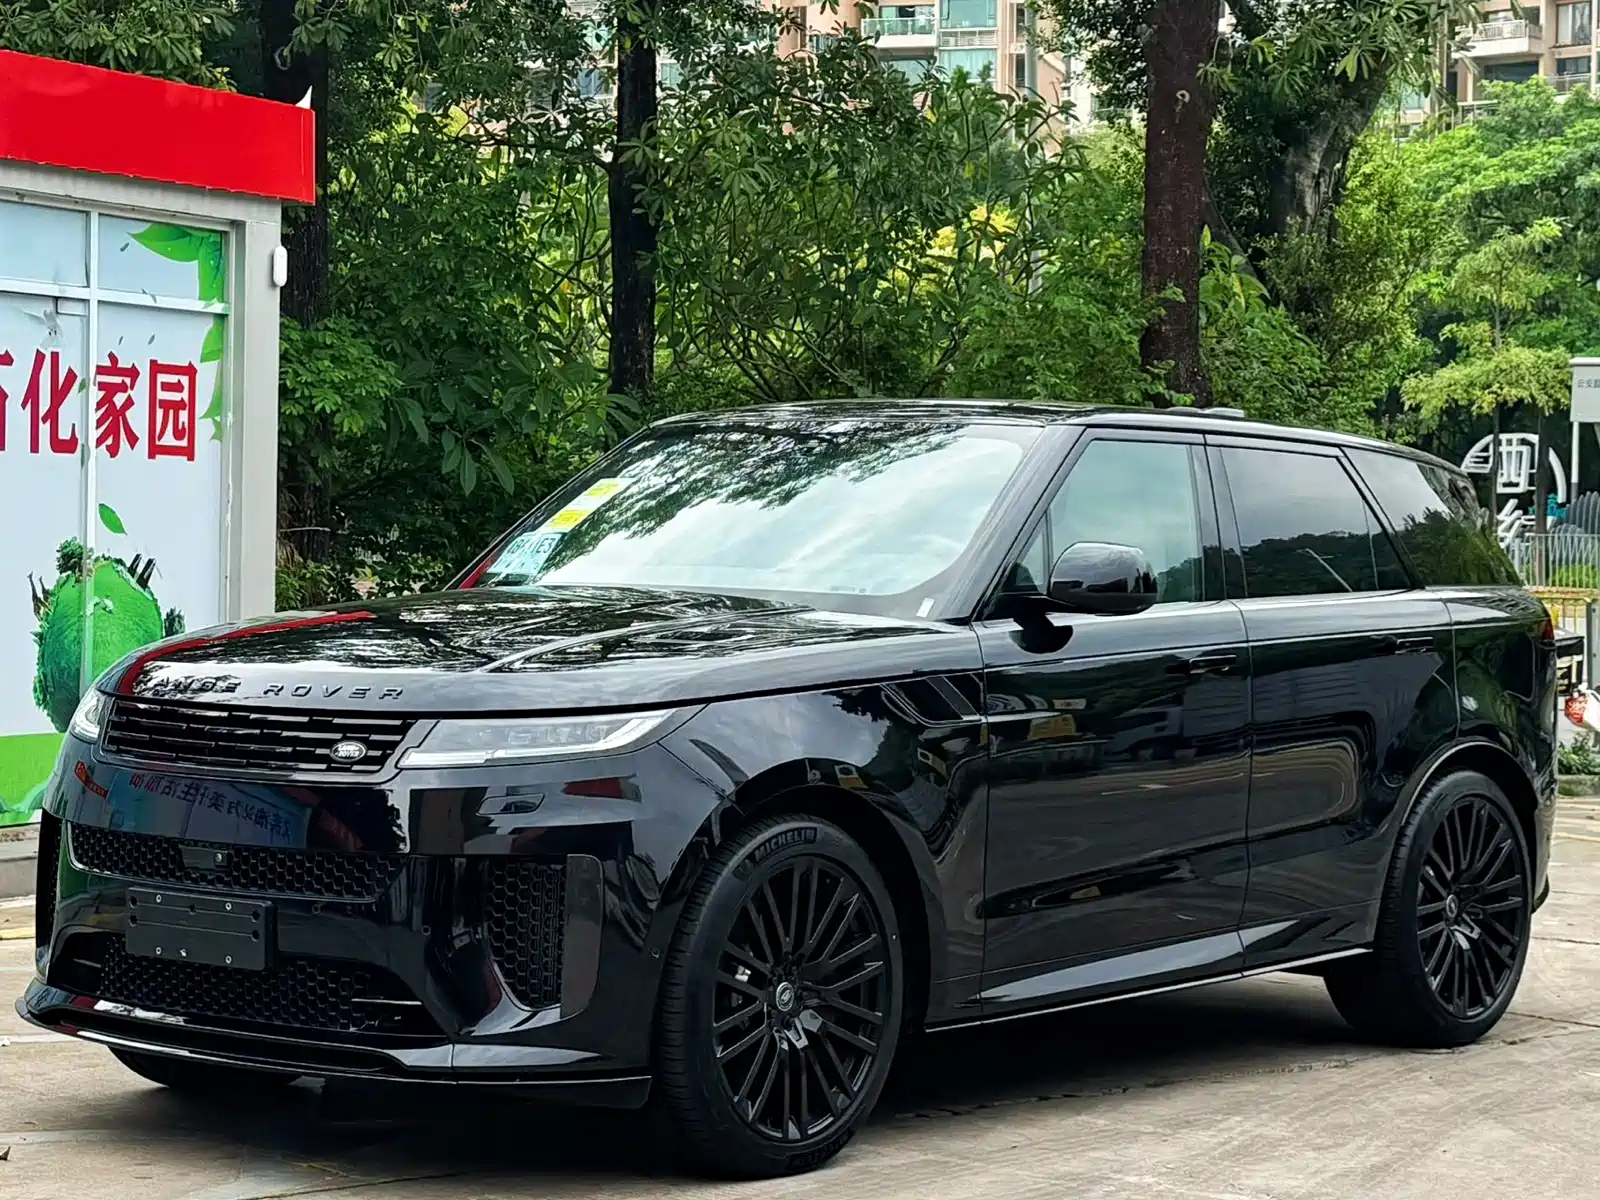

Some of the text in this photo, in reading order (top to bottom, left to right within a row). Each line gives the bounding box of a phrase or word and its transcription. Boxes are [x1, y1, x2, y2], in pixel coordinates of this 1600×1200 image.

[0, 348, 198, 461] 化家园
[263, 684, 404, 700] ROVER
